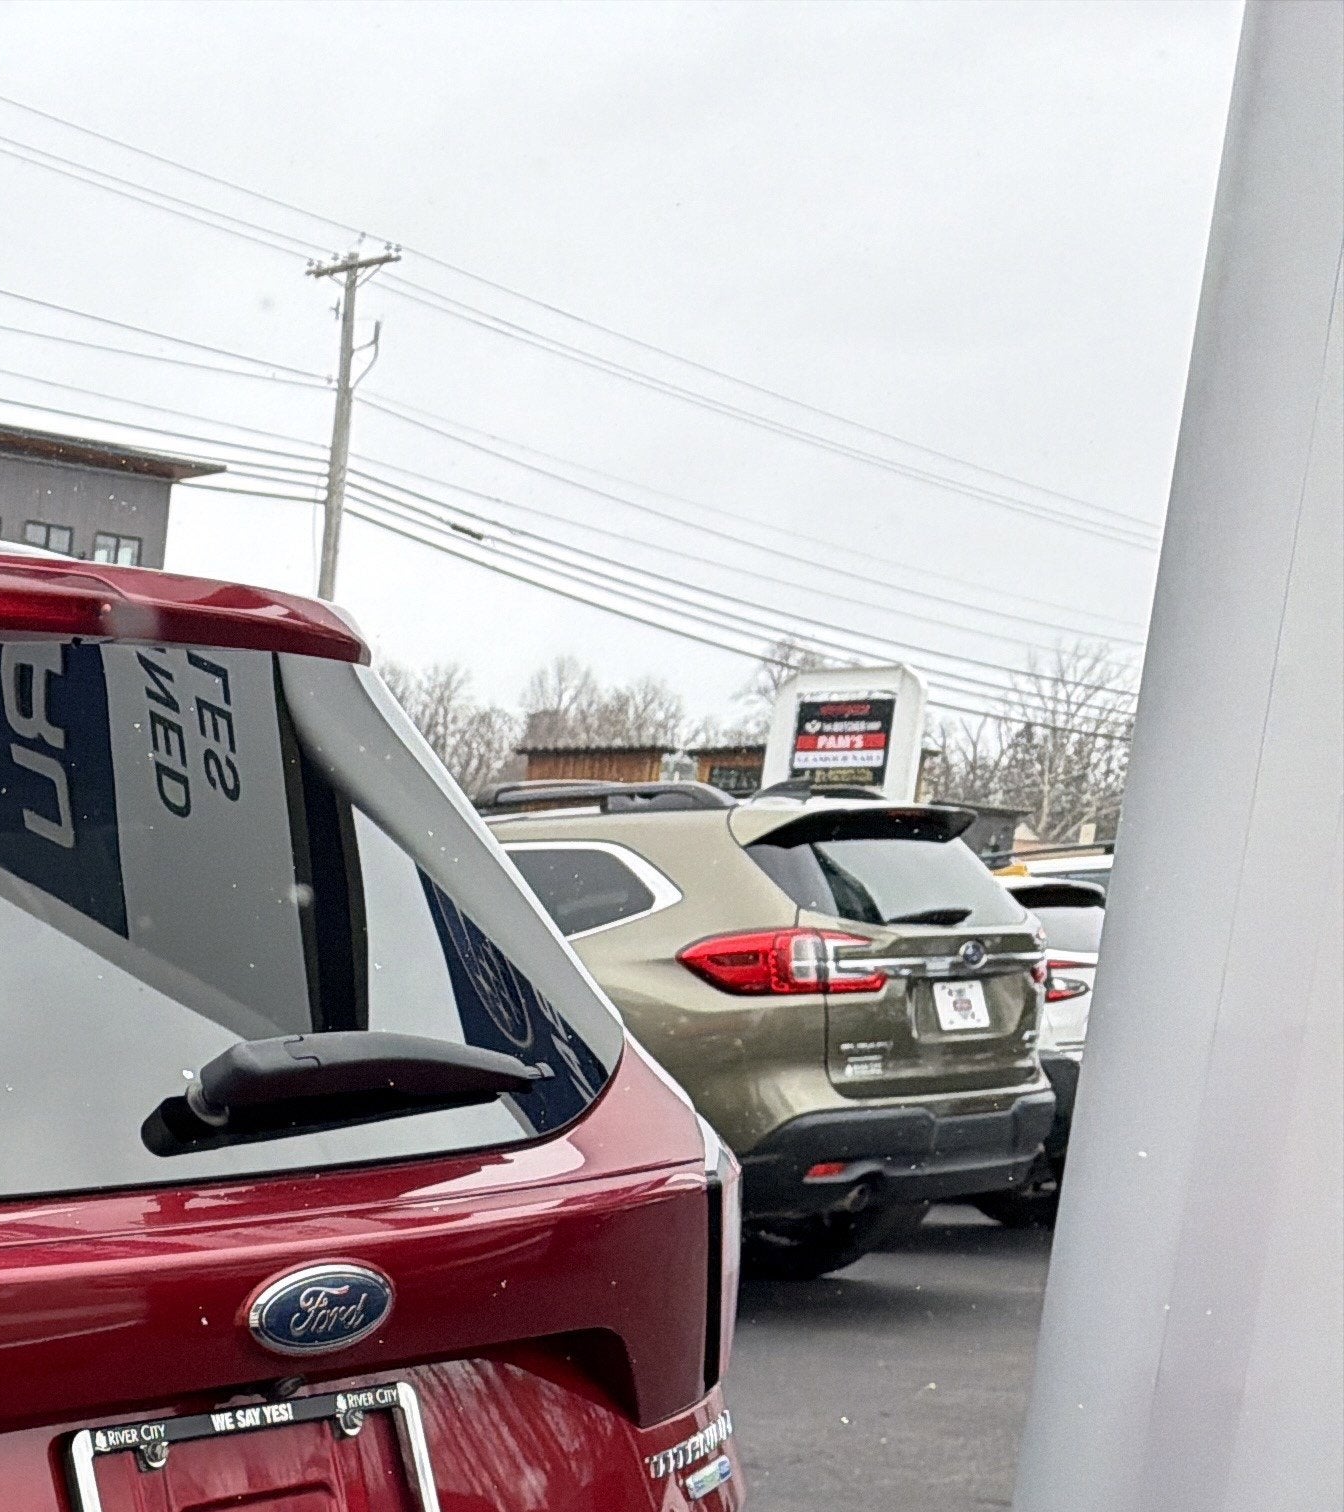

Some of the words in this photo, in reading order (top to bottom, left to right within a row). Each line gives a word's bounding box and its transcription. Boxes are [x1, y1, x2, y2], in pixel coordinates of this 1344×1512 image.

[289, 1284, 368, 1337] Ford
[346, 1391, 375, 1410] RIVER
[375, 1387, 400, 1405] CITY
[210, 1413, 235, 1432] WE
[235, 1407, 263, 1428] SAY
[263, 1403, 294, 1424] YES!
[106, 1427, 140, 1447] RIVER
[140, 1423, 167, 1442] CITY
